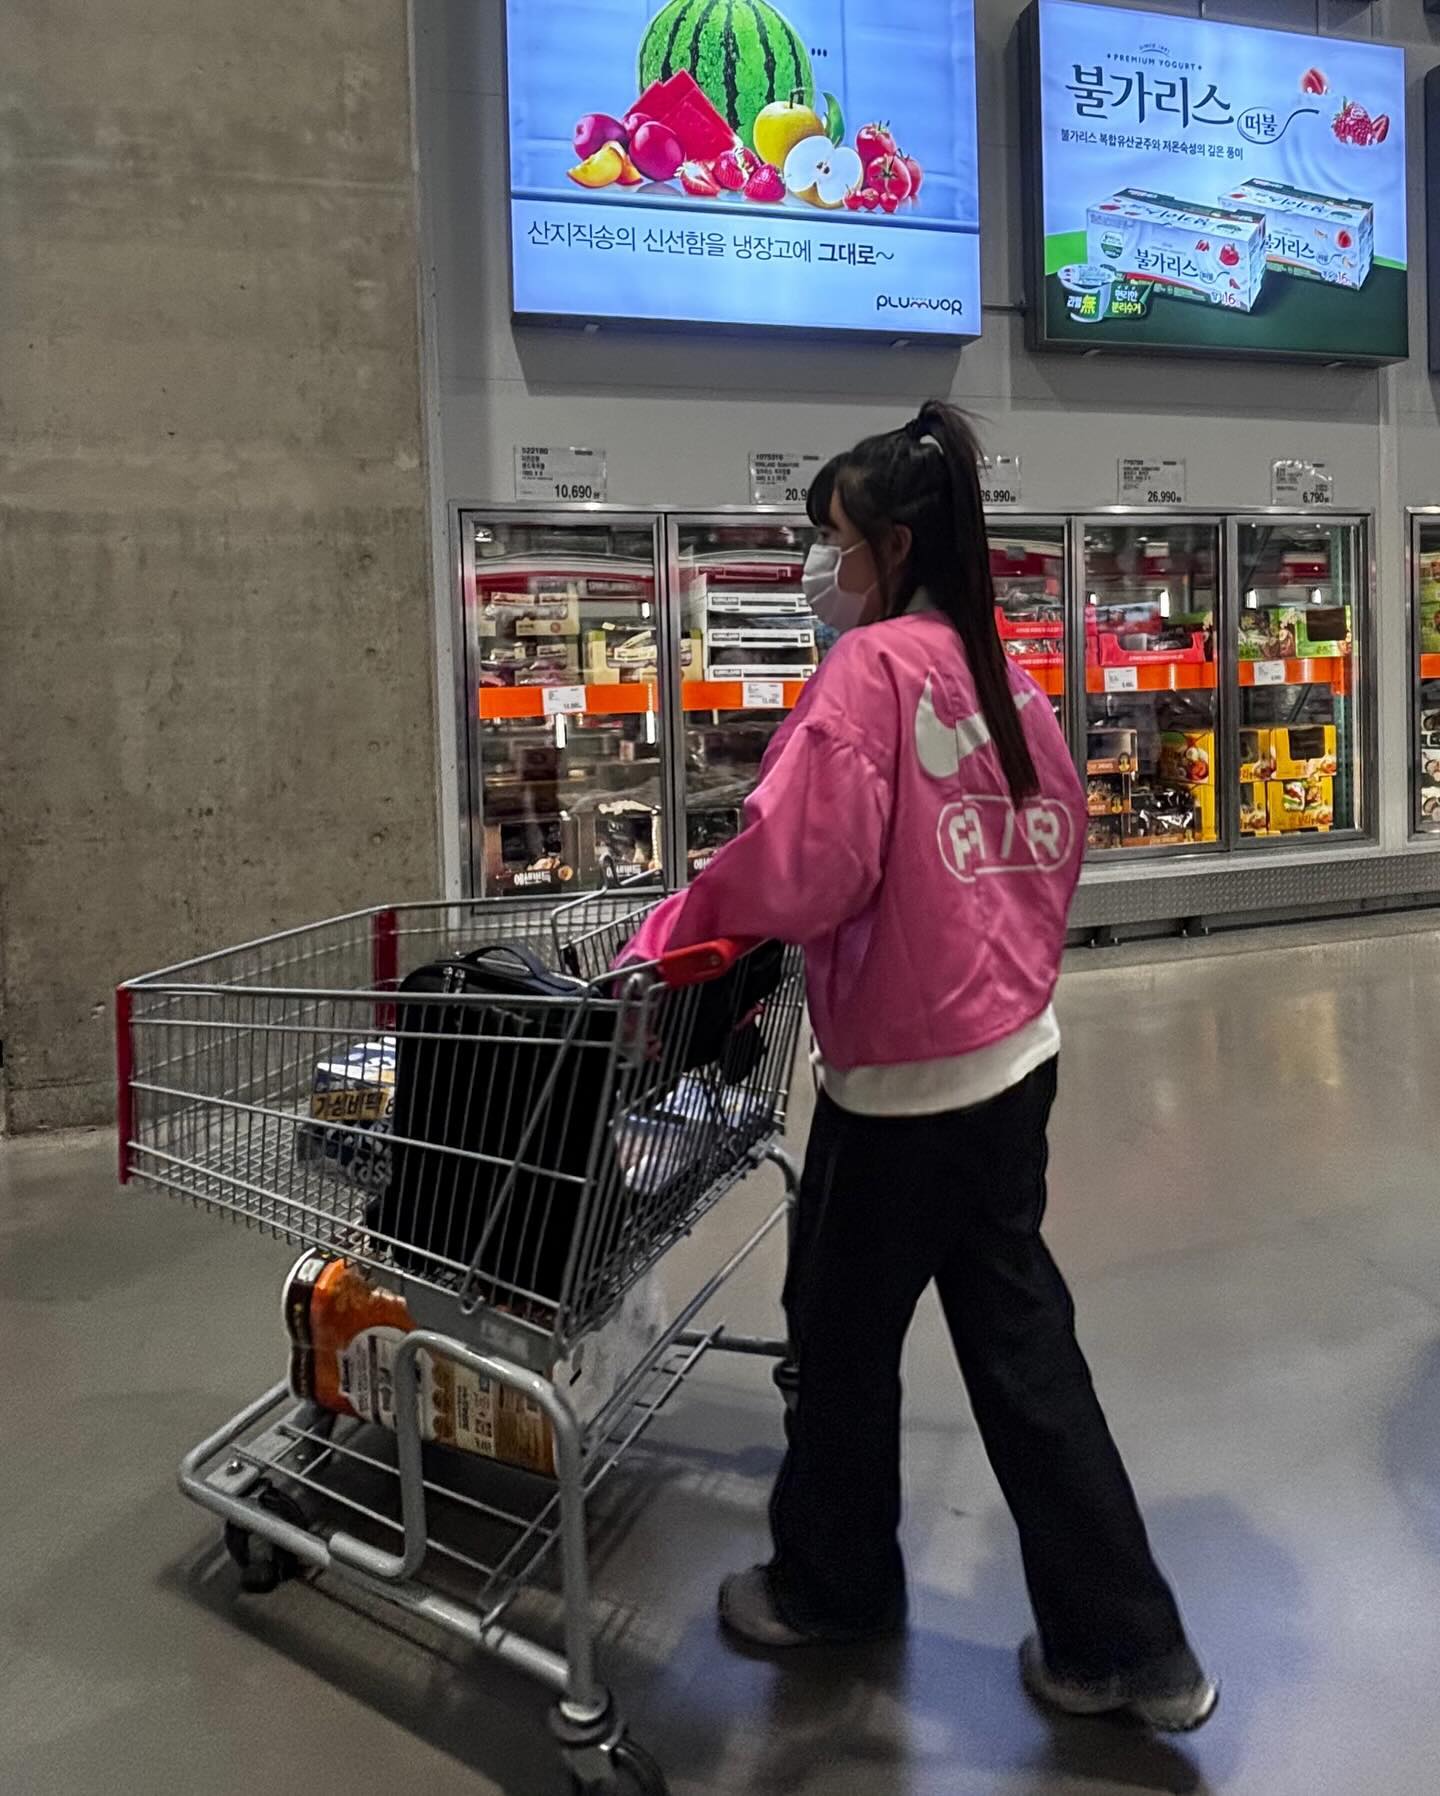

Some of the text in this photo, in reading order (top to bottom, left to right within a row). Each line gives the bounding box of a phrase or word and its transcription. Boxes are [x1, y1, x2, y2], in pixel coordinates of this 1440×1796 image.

[1114, 53, 1196, 70] PREMIUM YOGURT
[1065, 64, 1234, 129] 불가리스
[1246, 113, 1278, 137] 떠불
[1061, 128, 1243, 160] 불가리스 복합유산균주와 저온숙성의 깊은 풍미
[528, 220, 894, 266] 산지직송의 신선함을 냉장고에 그대로~
[1134, 248, 1198, 277] 불가리스
[1111, 301, 1141, 314] 분리수거
[1115, 289, 1138, 301] 편리한
